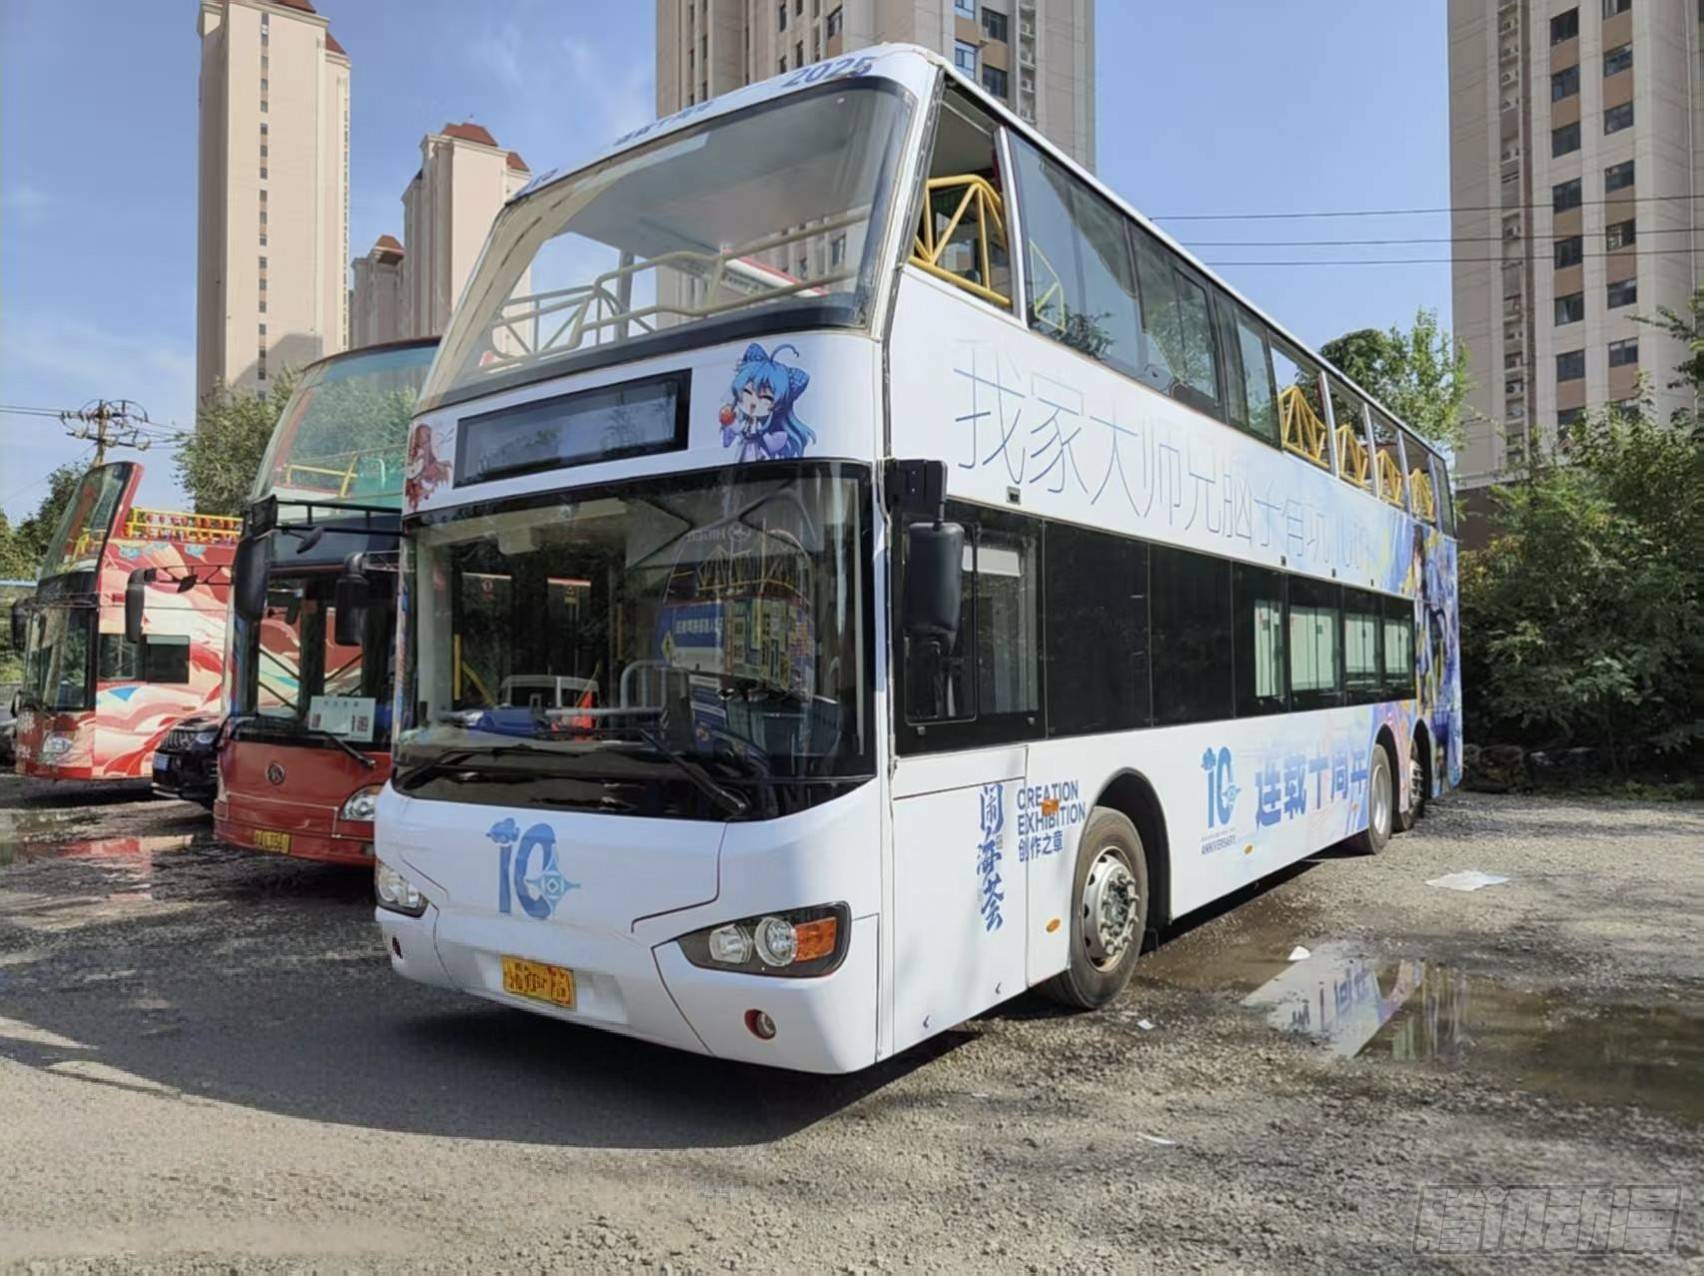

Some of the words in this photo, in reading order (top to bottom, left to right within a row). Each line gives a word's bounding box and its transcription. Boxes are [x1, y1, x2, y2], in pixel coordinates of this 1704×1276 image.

[781, 55, 876, 88] 2025
[1017, 780, 1079, 810] CREATION
[1017, 803, 1086, 836] EXHIBITION
[1018, 831, 1064, 863] 创作之章
